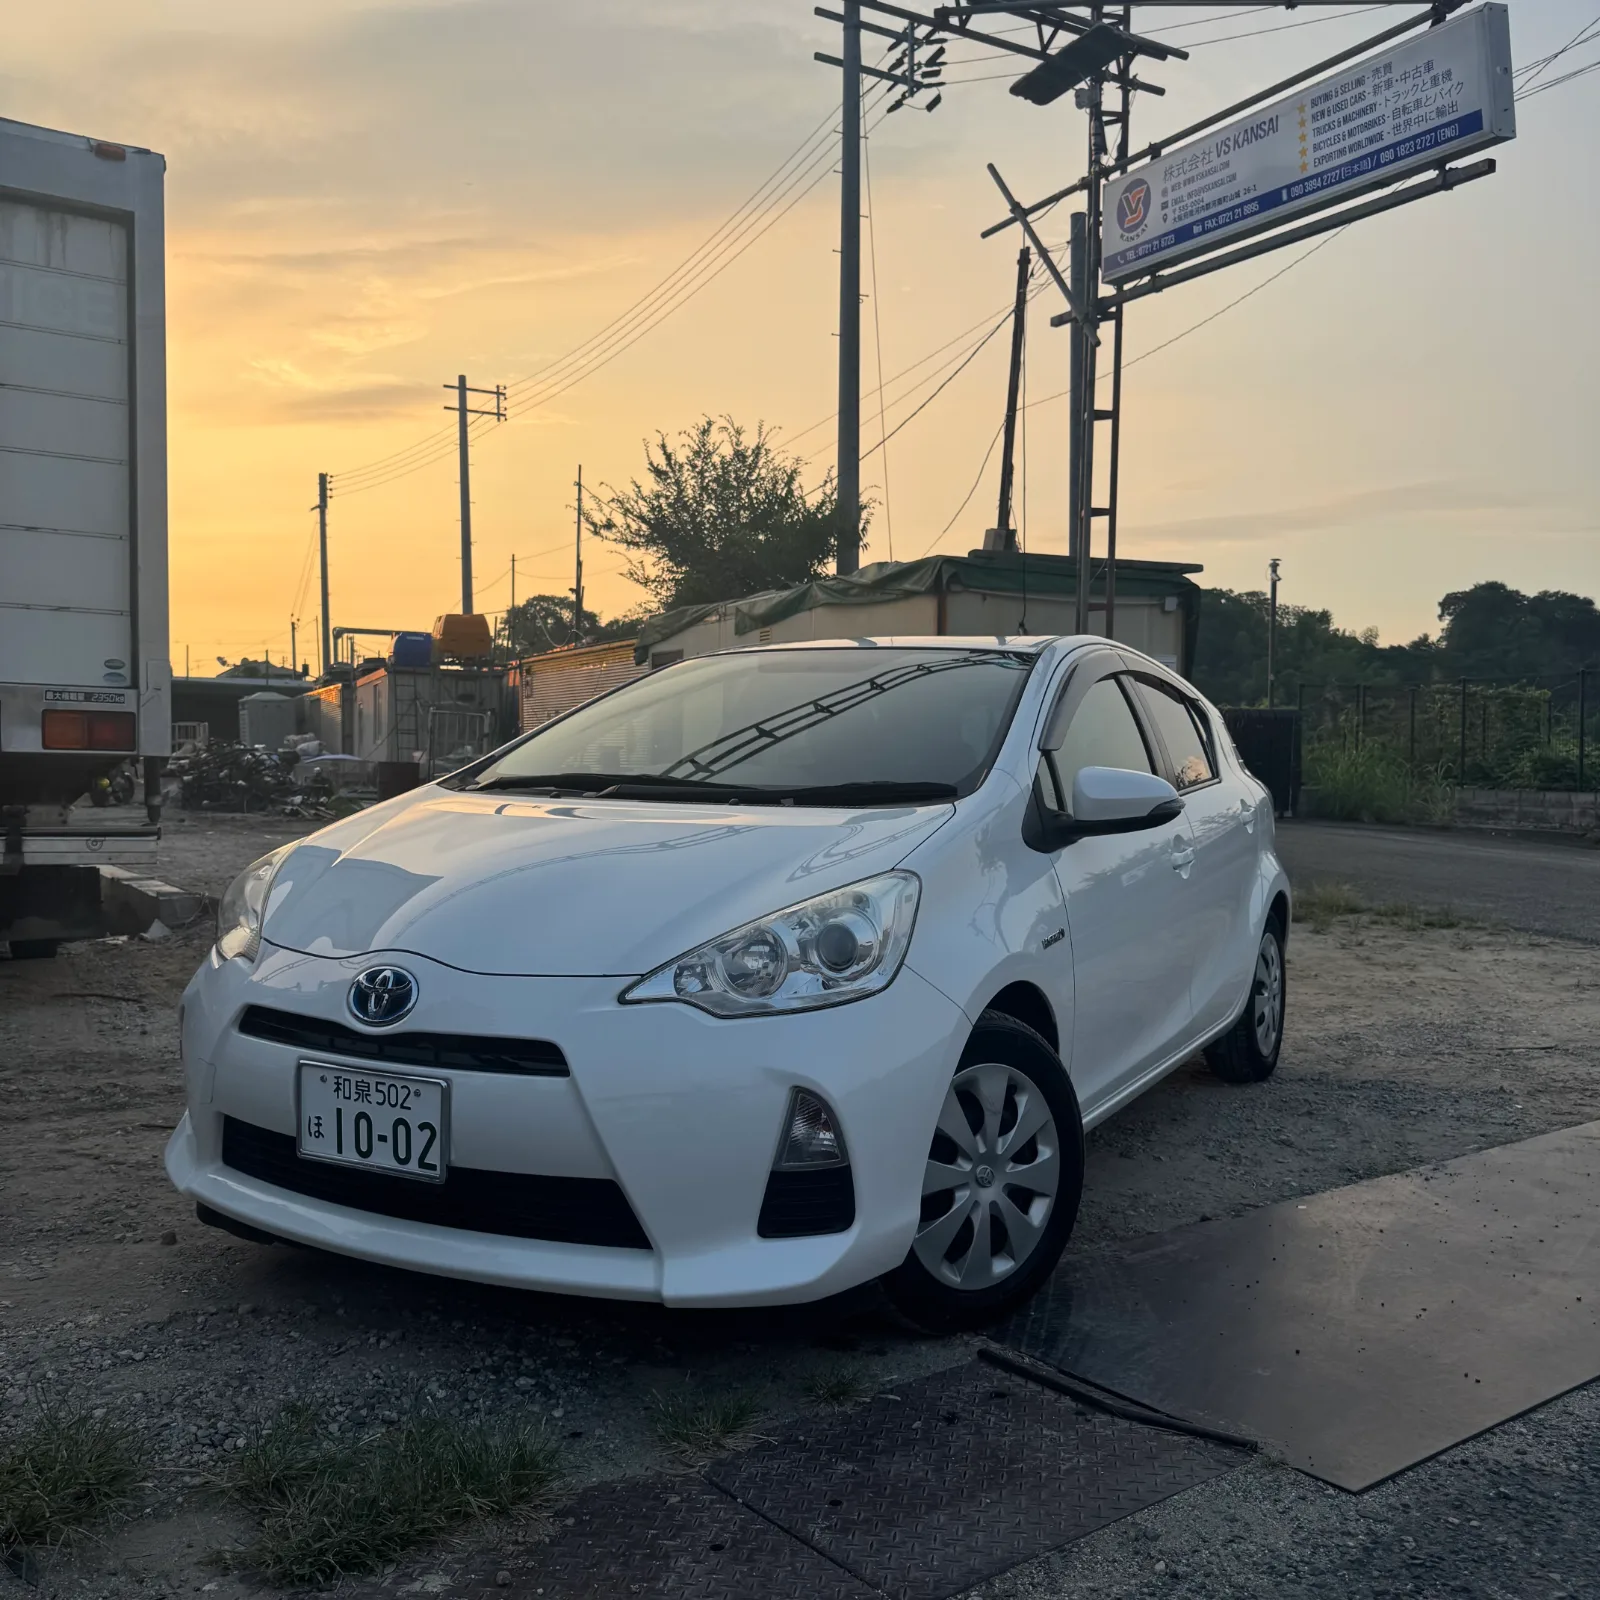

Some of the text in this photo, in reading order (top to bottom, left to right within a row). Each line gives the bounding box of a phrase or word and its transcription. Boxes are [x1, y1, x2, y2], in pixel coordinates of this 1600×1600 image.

[1310, 90, 1333, 109] BUYING
[1334, 88, 1339, 98] &
[1340, 75, 1365, 95] SELLING
[1372, 61, 1393, 82] 売買
[1311, 108, 1325, 124] NEW
[1327, 106, 1331, 117] &
[1332, 98, 1349, 114] USED
[1350, 90, 1366, 106] CARS
[1372, 59, 1434, 97] 新車・中古車
[1312, 120, 1336, 138] TRUCKS
[1337, 118, 1341, 128] &
[1342, 101, 1377, 126] MACHINERY
[1384, 68, 1453, 108] トラックと重機
[1313, 134, 1341, 153] BICYCLES
[1342, 131, 1346, 141] &
[1347, 114, 1386, 139] MOTORBIKES
[1392, 80, 1464, 120] 自転車とバイク
[1164, 114, 1279, 183] 株式会社 VS KANSAI
[1290, 185, 1303, 198] 090
[1304, 177, 1321, 192] 3894
[1323, 170, 1340, 186] 2727
[1380, 149, 1394, 163] 090
[1396, 141, 1415, 157] 1823
[1416, 132, 1435, 149] 2727
[1314, 146, 1347, 168] EXPORTING
[1348, 130, 1384, 154] WORLDWIDE
[1392, 100, 1459, 136] 世界中に輸出
[1120, 224, 1148, 242] KANSAI
[1153, 240, 1159, 251] 21
[1234, 208, 1242, 219] 21
[308, 1108, 437, 1171] ほ 10-02
